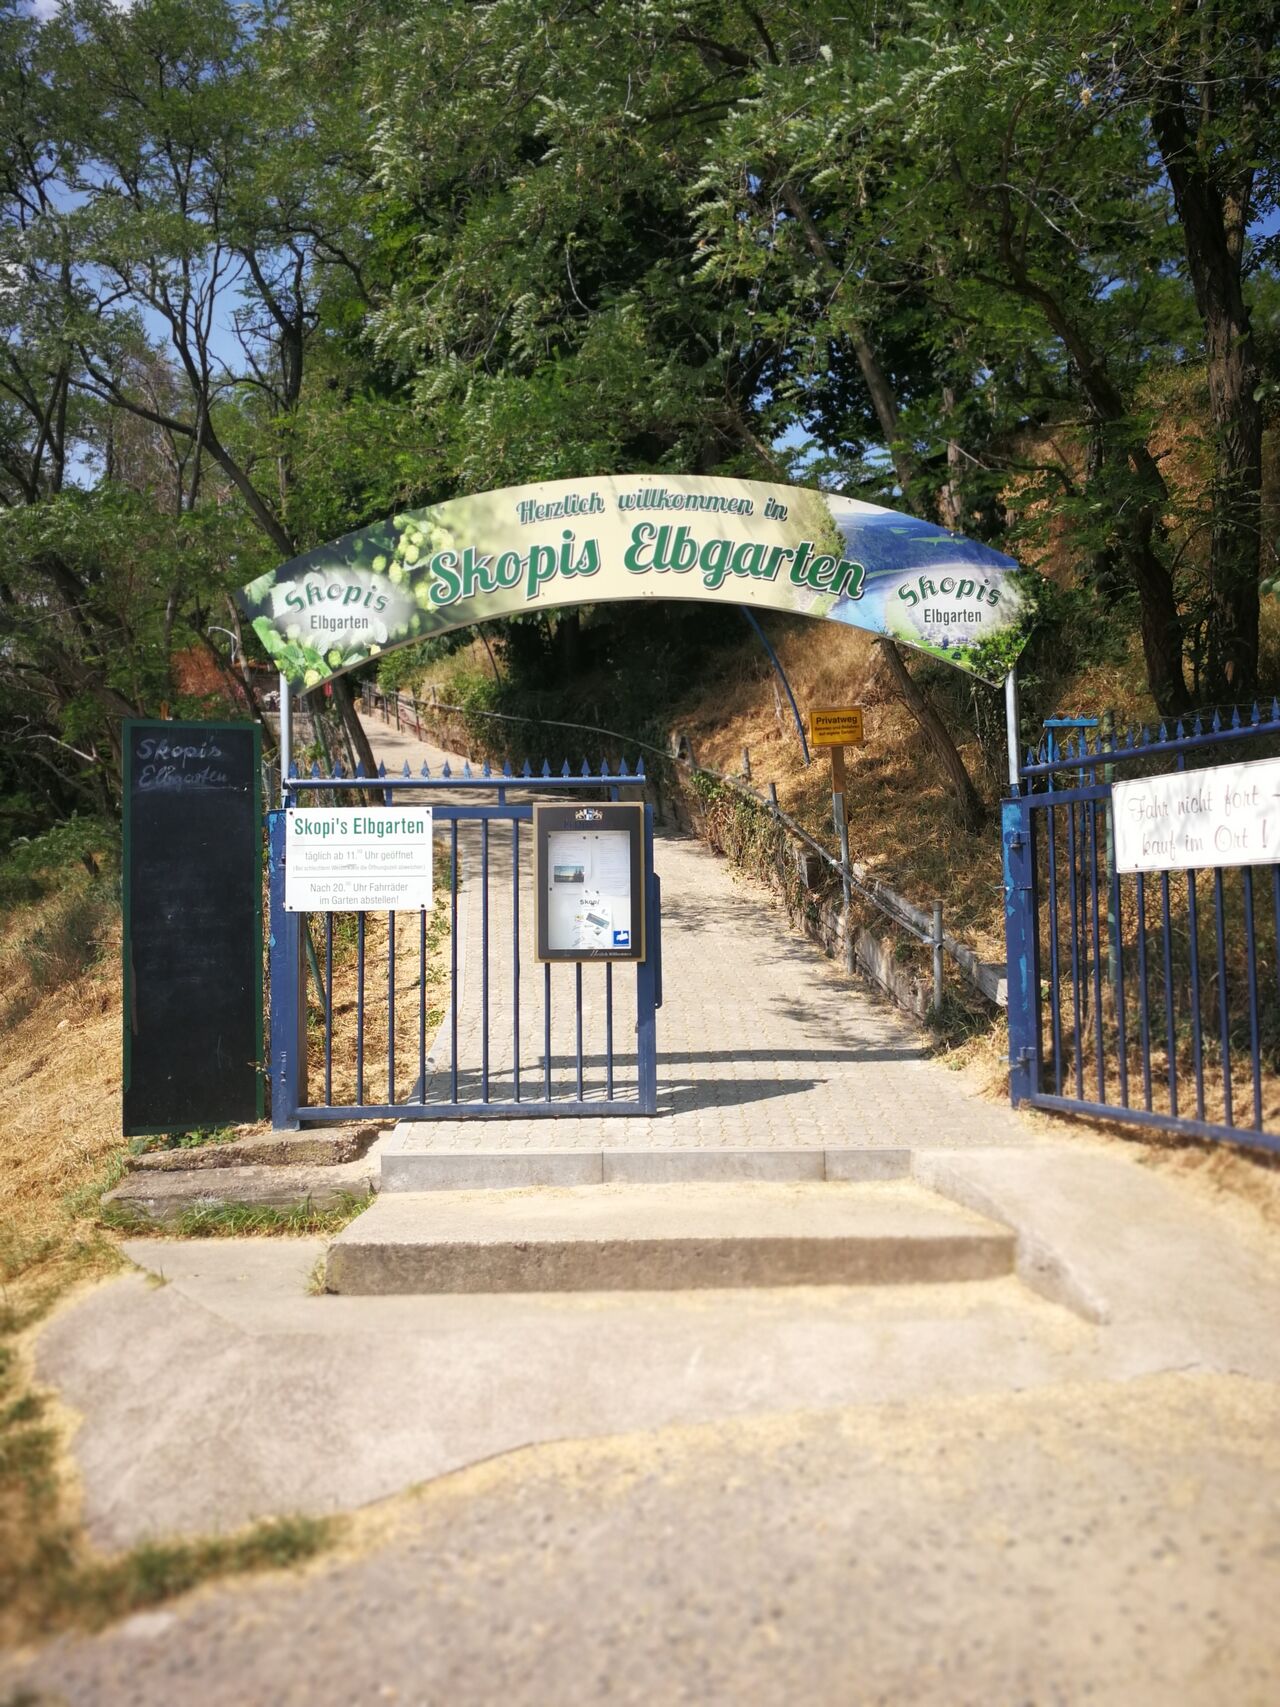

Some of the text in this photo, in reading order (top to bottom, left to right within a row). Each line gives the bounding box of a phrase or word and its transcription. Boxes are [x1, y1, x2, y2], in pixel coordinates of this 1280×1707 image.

[516, 488, 788, 524] Herzlich willkommen in
[429, 522, 866, 606] Skopis Elbgarten
[285, 581, 390, 614] Skopis
[898, 576, 1003, 608] Skopis
[310, 615, 369, 632] Elbgarten
[924, 608, 982, 626] Elbgarten
[816, 716, 858, 725] Privatweg
[1127, 794, 1169, 822] Fahr
[1177, 788, 1213, 815] nicht
[1224, 784, 1261, 817] fort
[294, 817, 425, 838] Skopi's Elbgarten
[1142, 830, 1177, 861] kauf
[1184, 834, 1204, 853] im
[1214, 825, 1249, 852] Ort
[305, 851, 332, 861] täglich
[333, 851, 344, 859] ab
[364, 851, 379, 860] Uhr
[380, 850, 414, 861] geöffnet
[310, 883, 331, 893] Nach
[353, 883, 368, 892] Uhr
[369, 882, 408, 892] Fahrräder
[319, 895, 400, 905] im Garten abstellen!
